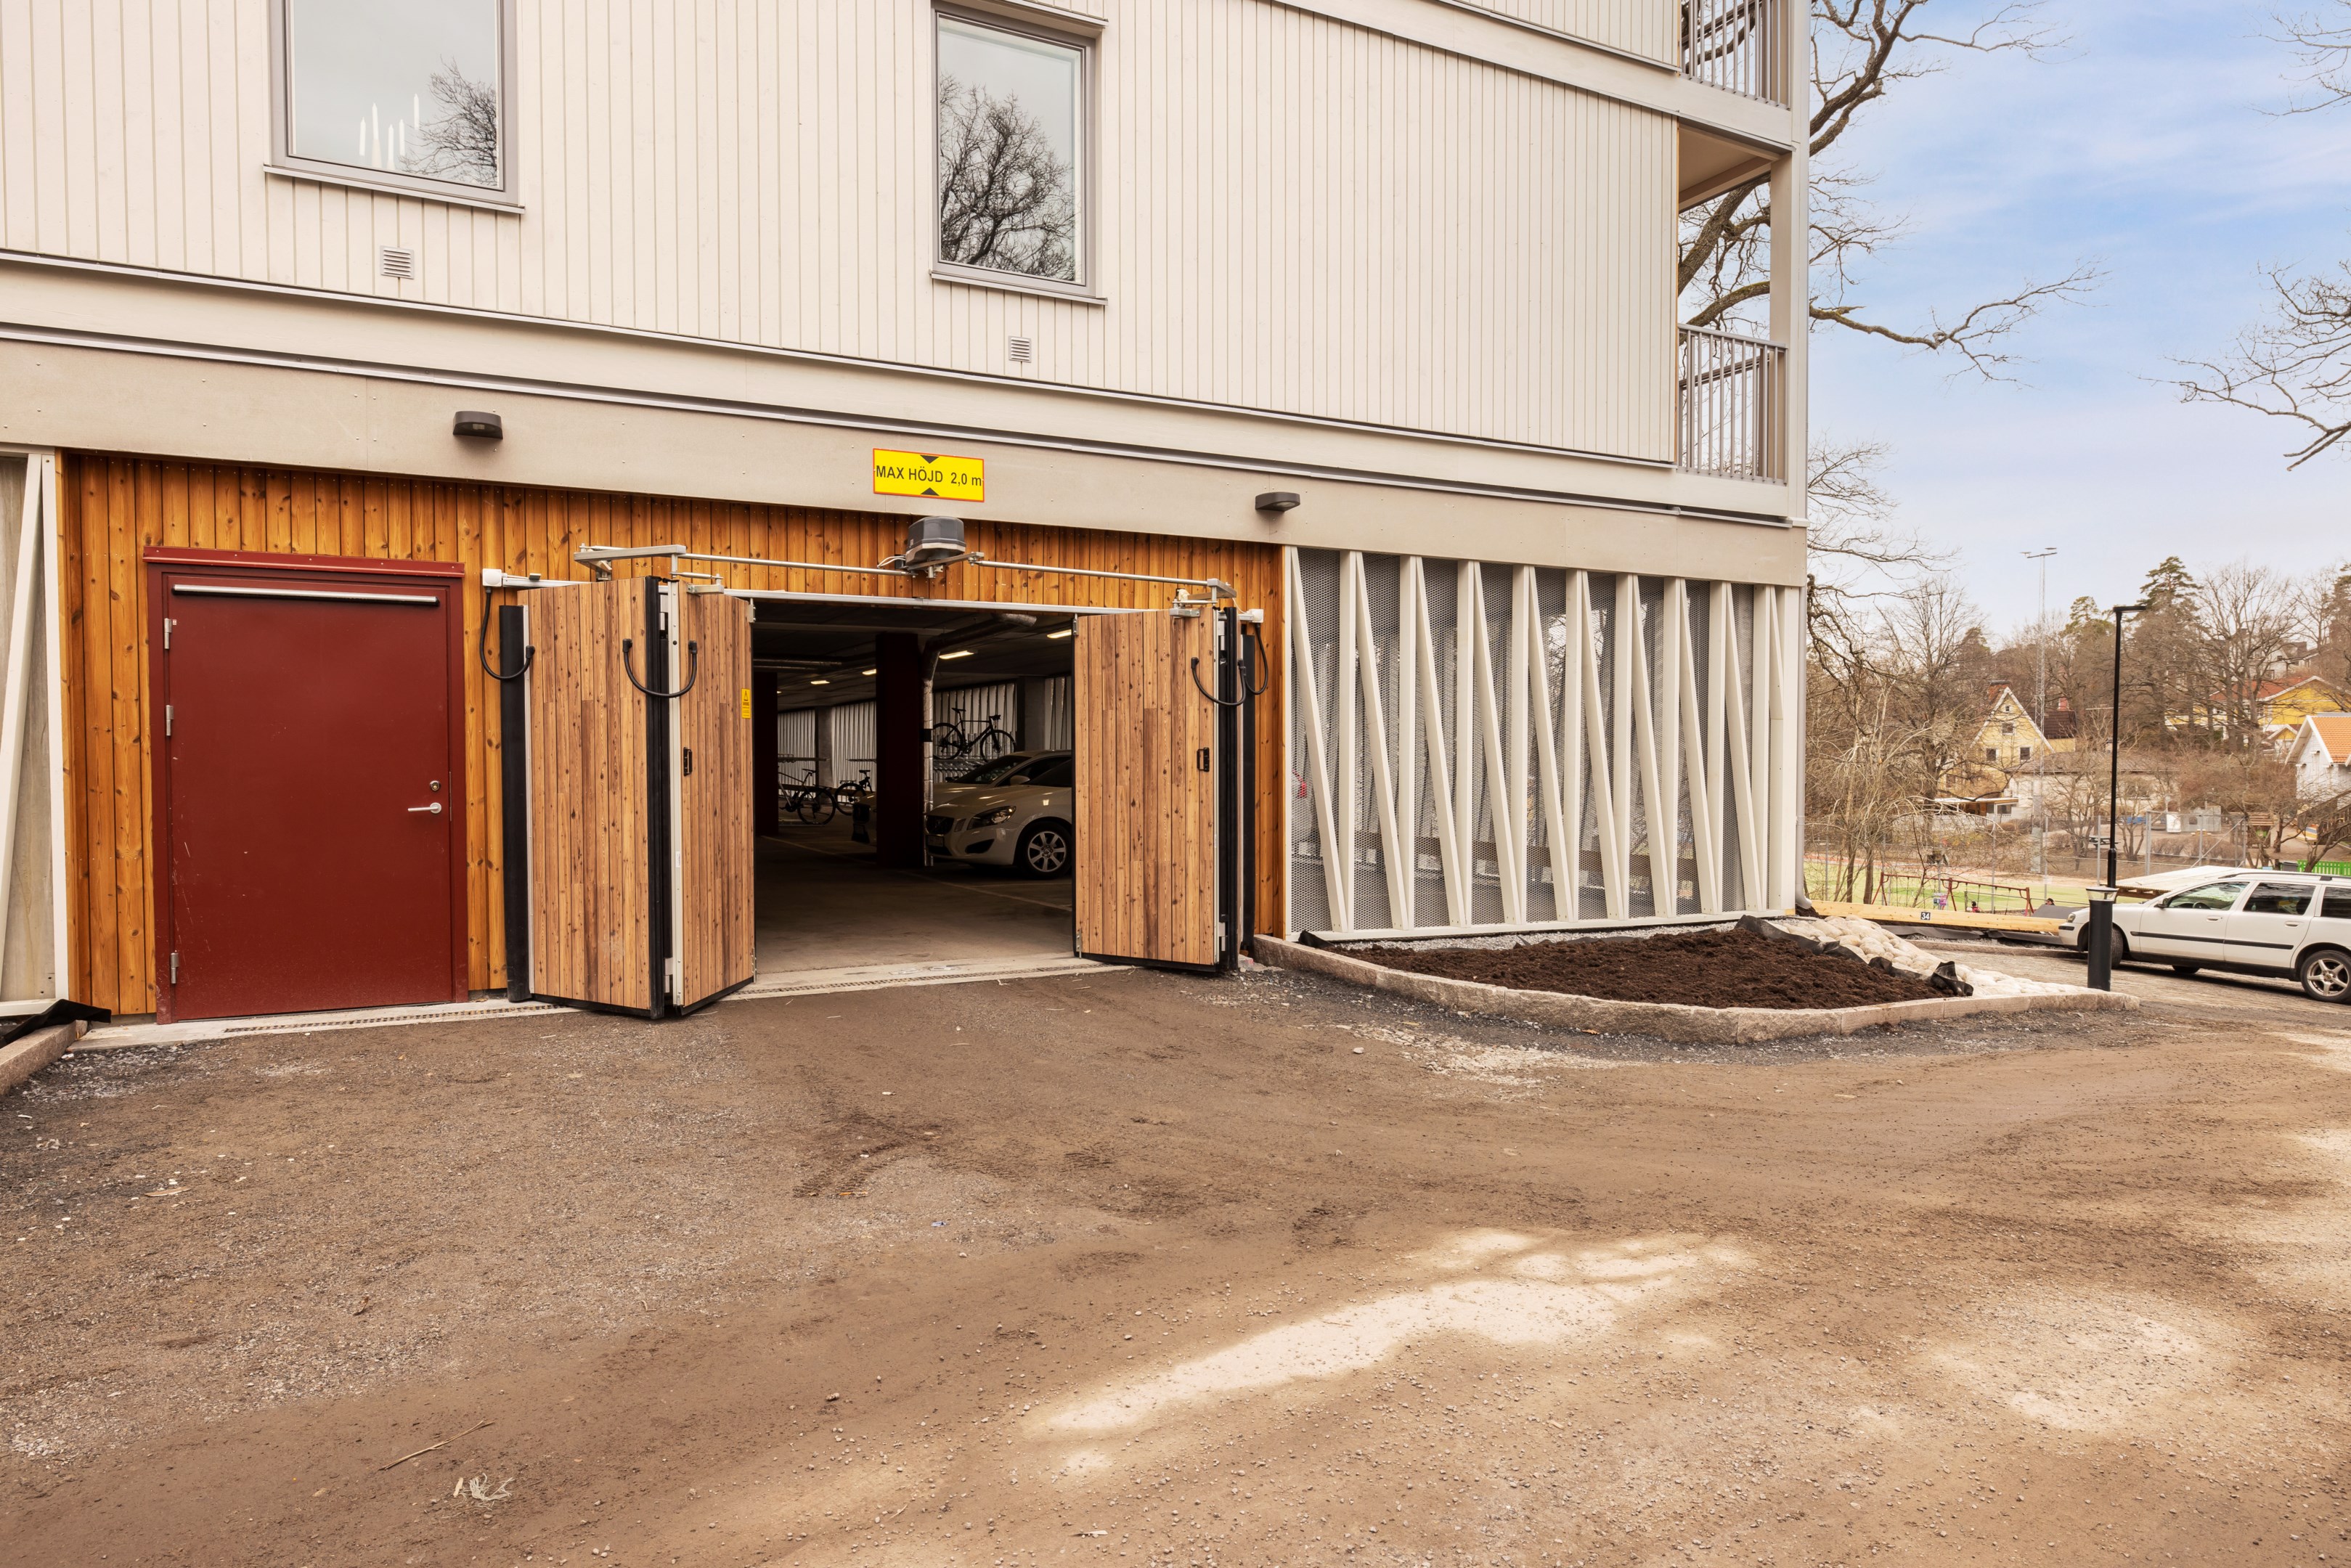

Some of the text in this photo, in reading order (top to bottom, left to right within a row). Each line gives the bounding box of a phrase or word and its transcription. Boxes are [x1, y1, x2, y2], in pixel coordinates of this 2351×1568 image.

[876, 465, 982, 487] MAX HÖJD 2,0 m
